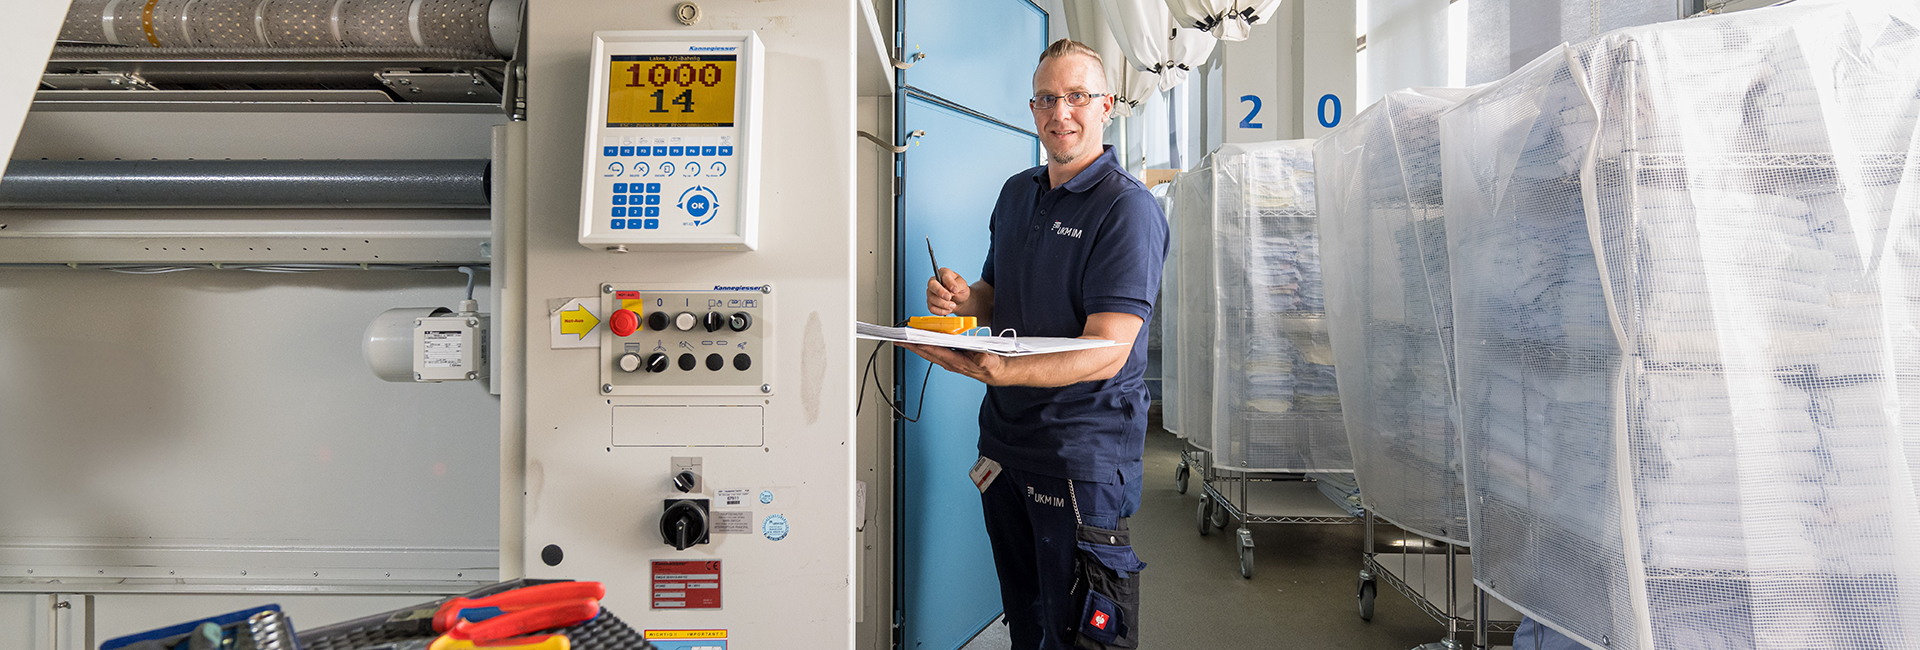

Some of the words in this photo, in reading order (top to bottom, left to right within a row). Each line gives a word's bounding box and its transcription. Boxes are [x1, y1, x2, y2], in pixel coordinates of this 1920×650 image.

[626, 64, 722, 87] 1000
[649, 89, 695, 113] 14
[1239, 95, 1262, 129] 2
[1317, 94, 1342, 128] 0
[691, 202, 705, 210] OK
[1034, 493, 1052, 505] UKM
[1053, 496, 1065, 508] IM
